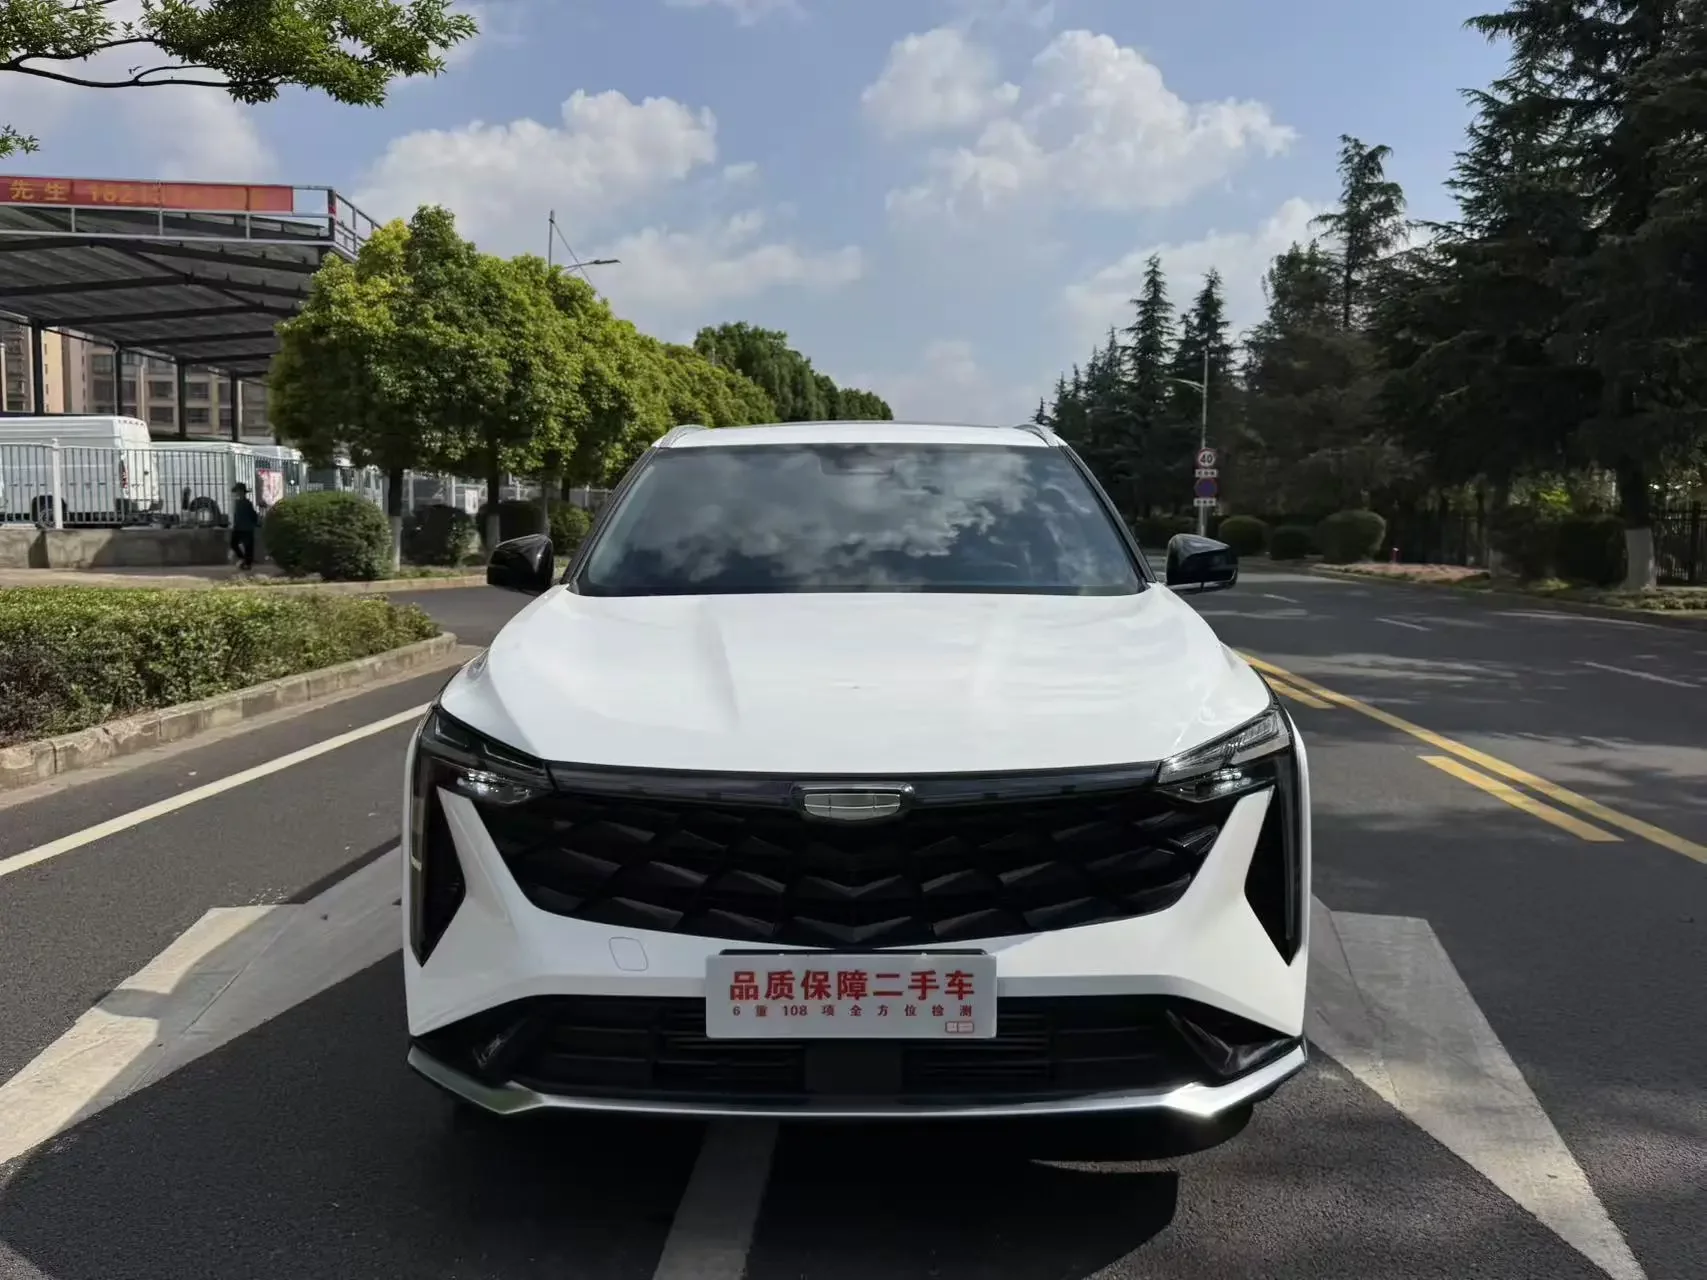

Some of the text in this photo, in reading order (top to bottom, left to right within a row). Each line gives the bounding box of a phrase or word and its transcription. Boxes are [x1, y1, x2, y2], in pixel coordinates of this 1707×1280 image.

[9, 179, 68, 201] 先生
[1200, 454, 1213, 464] 40
[730, 970, 975, 1001] 品质保障二手车
